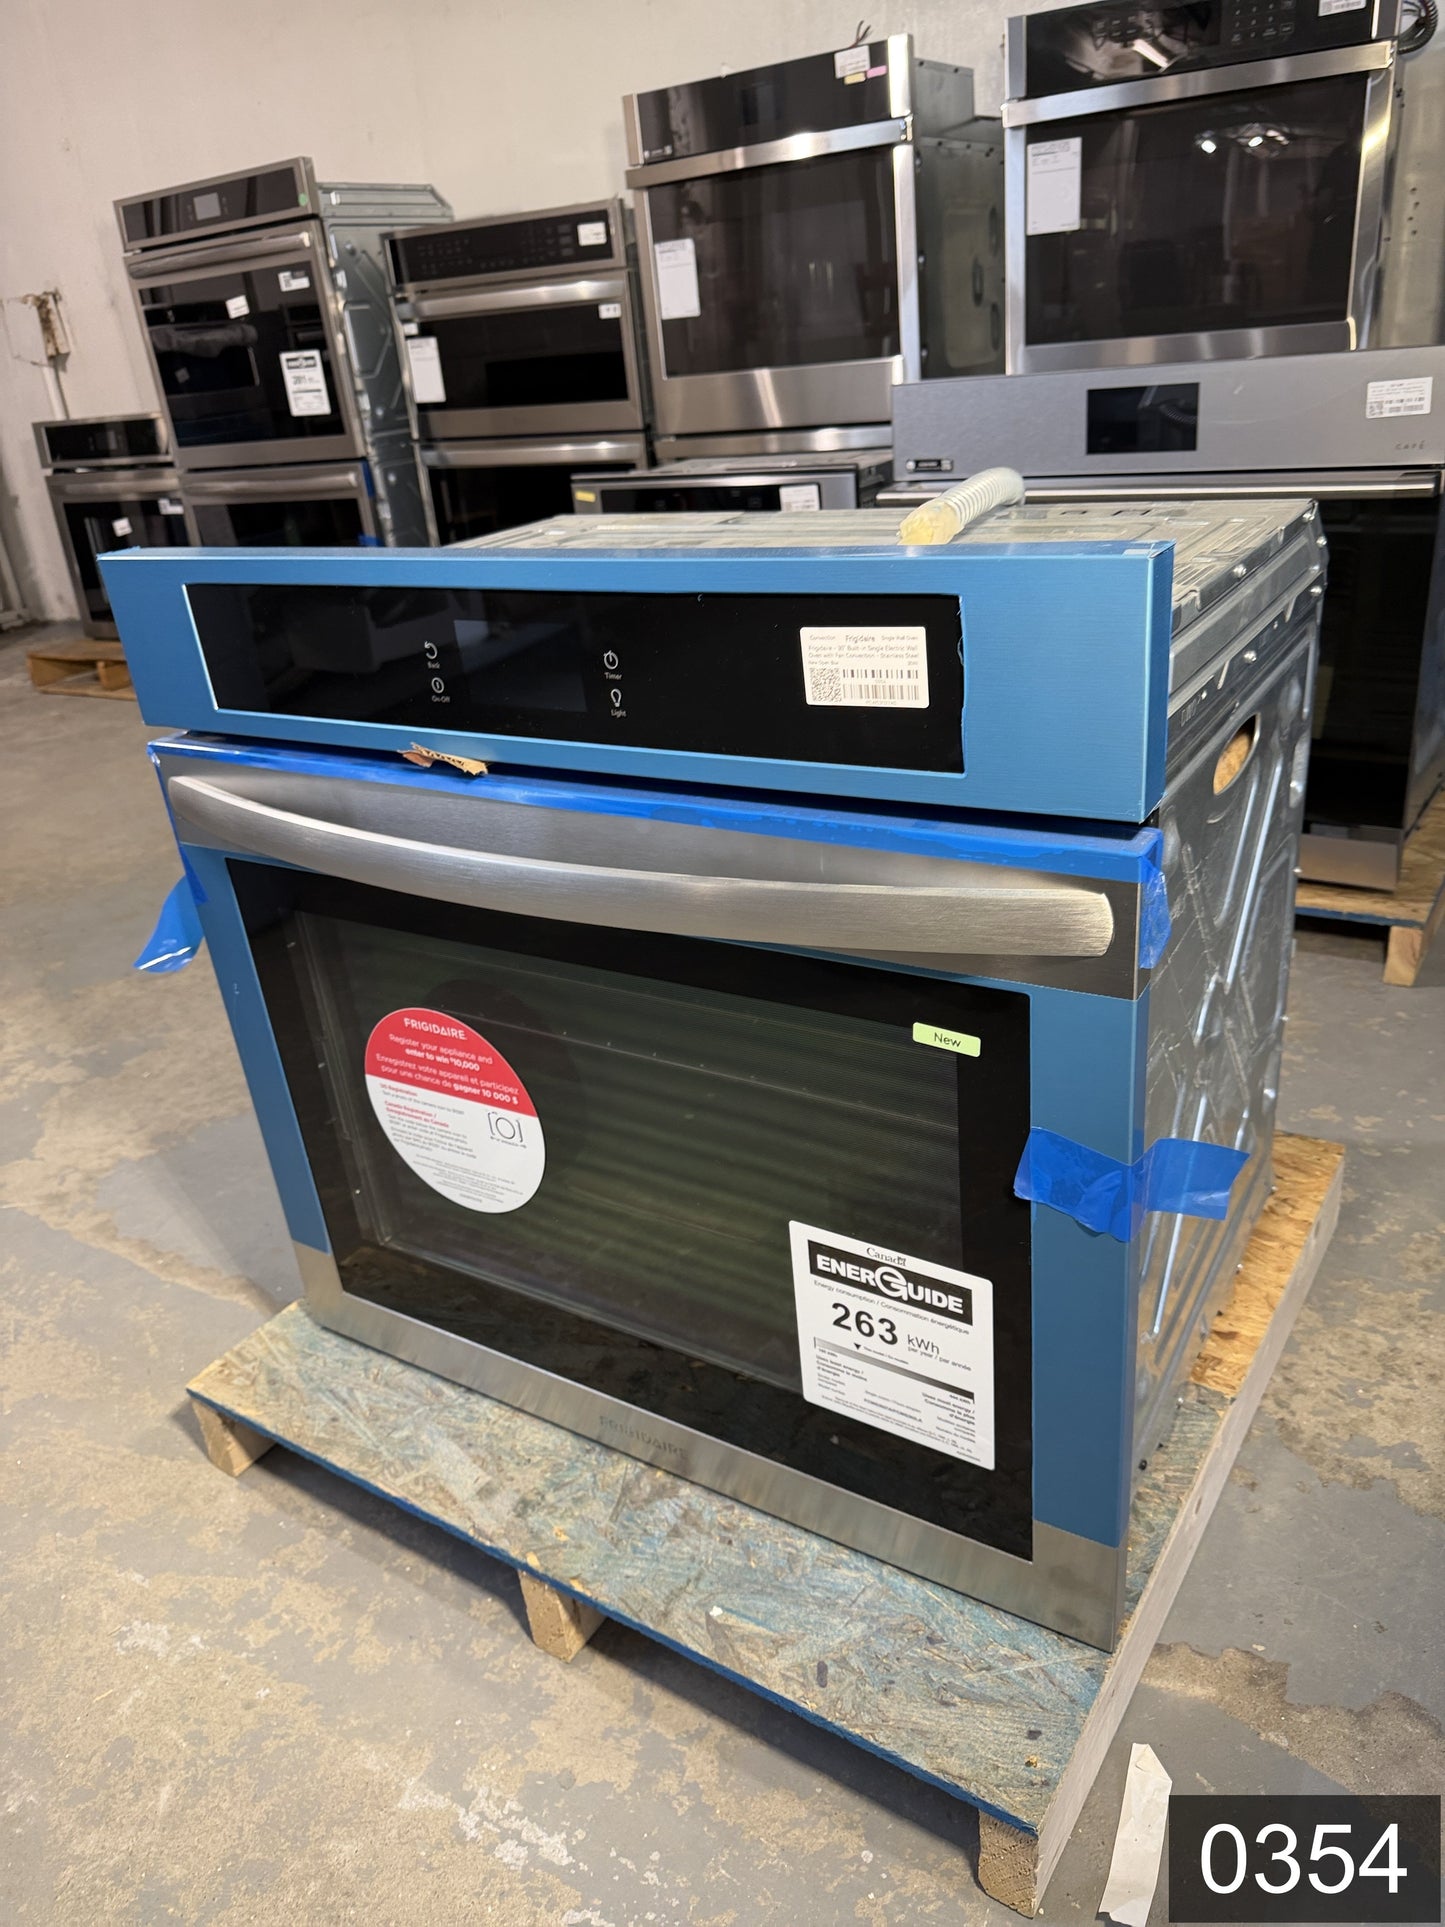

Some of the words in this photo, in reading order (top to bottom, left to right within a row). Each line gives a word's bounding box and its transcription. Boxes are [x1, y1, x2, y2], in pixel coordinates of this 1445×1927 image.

[845, 634, 875, 644] Frigidaire
[604, 671, 622, 680] Timer
[611, 709, 626, 719] Light
[403, 1017, 467, 1040] FRIGIDAIRE
[934, 1032, 961, 1047] New
[388, 1033, 419, 1047] Register
[420, 1041, 438, 1052] your
[439, 1045, 477, 1061] appliance
[477, 1055, 493, 1065] and
[405, 1048, 425, 1059] enter
[426, 1053, 435, 1061] to
[435, 1055, 450, 1065] win
[375, 1053, 417, 1071] Enregistrez
[418, 1063, 438, 1075] votre
[438, 1069, 469, 1084] appareil
[470, 1077, 479, 1086] et
[479, 1079, 520, 1095] participez
[381, 1065, 398, 1077] pour
[399, 1070, 414, 1079] une
[414, 1070, 441, 1086] chance
[441, 1079, 452, 1089] de
[453, 1082, 481, 1097] gagner
[481, 1088, 492, 1098] 10
[492, 1091, 511, 1104] 000
[511, 1096, 519, 1106] $
[866, 1247, 907, 1267] Canada
[816, 1253, 964, 1315] ENERGUIDE
[813, 1279, 834, 1292] Energy
[836, 1286, 876, 1304] consumption
[880, 1301, 929, 1322] Consommation
[831, 1302, 898, 1345] 263
[907, 1334, 940, 1355] kWh
[920, 1350, 933, 1359] year
[939, 1356, 950, 1364] per
[951, 1360, 972, 1372] année
